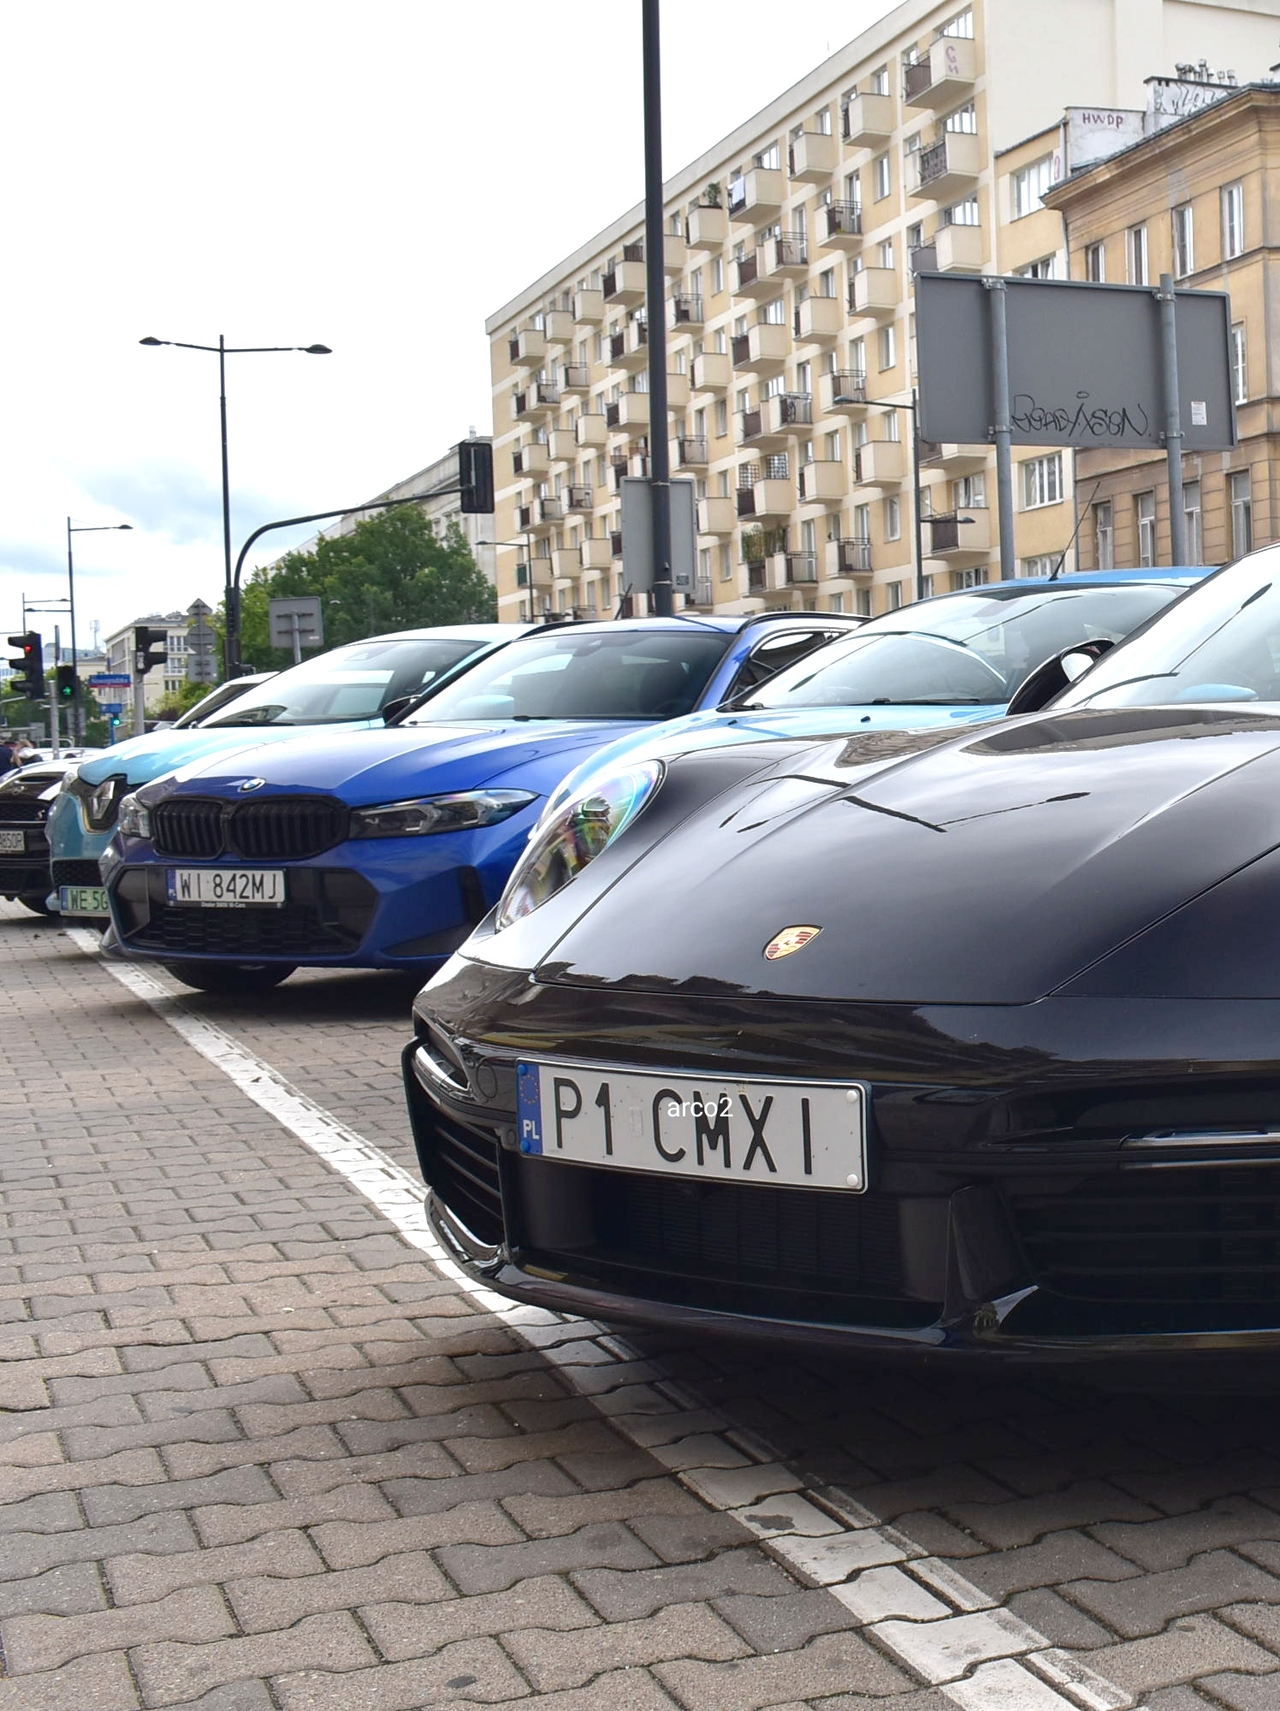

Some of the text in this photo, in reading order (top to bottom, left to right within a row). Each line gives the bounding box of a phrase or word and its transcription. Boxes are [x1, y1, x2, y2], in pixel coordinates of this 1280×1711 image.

[1083, 112, 1123, 129] HWDP
[180, 873, 276, 899] WI 842MJ
[71, 890, 88, 910] WE
[523, 1119, 540, 1140] PL
[553, 1077, 812, 1175] P1 CMXI
